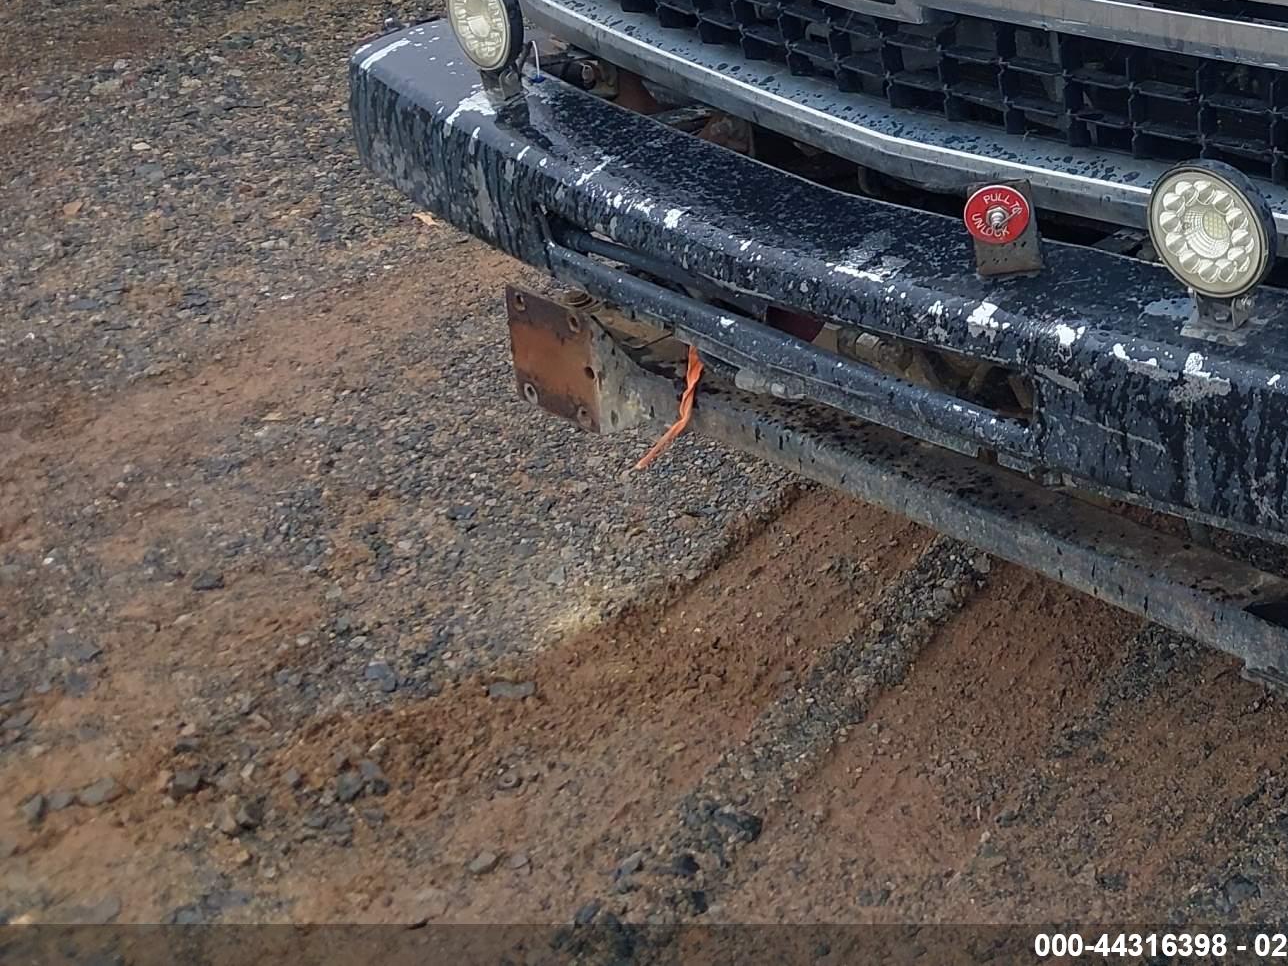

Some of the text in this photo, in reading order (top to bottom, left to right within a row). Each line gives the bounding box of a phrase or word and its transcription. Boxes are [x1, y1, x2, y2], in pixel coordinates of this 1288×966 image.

[983, 193, 1023, 215] PULL TO
[971, 214, 1010, 237] UNLOCK
